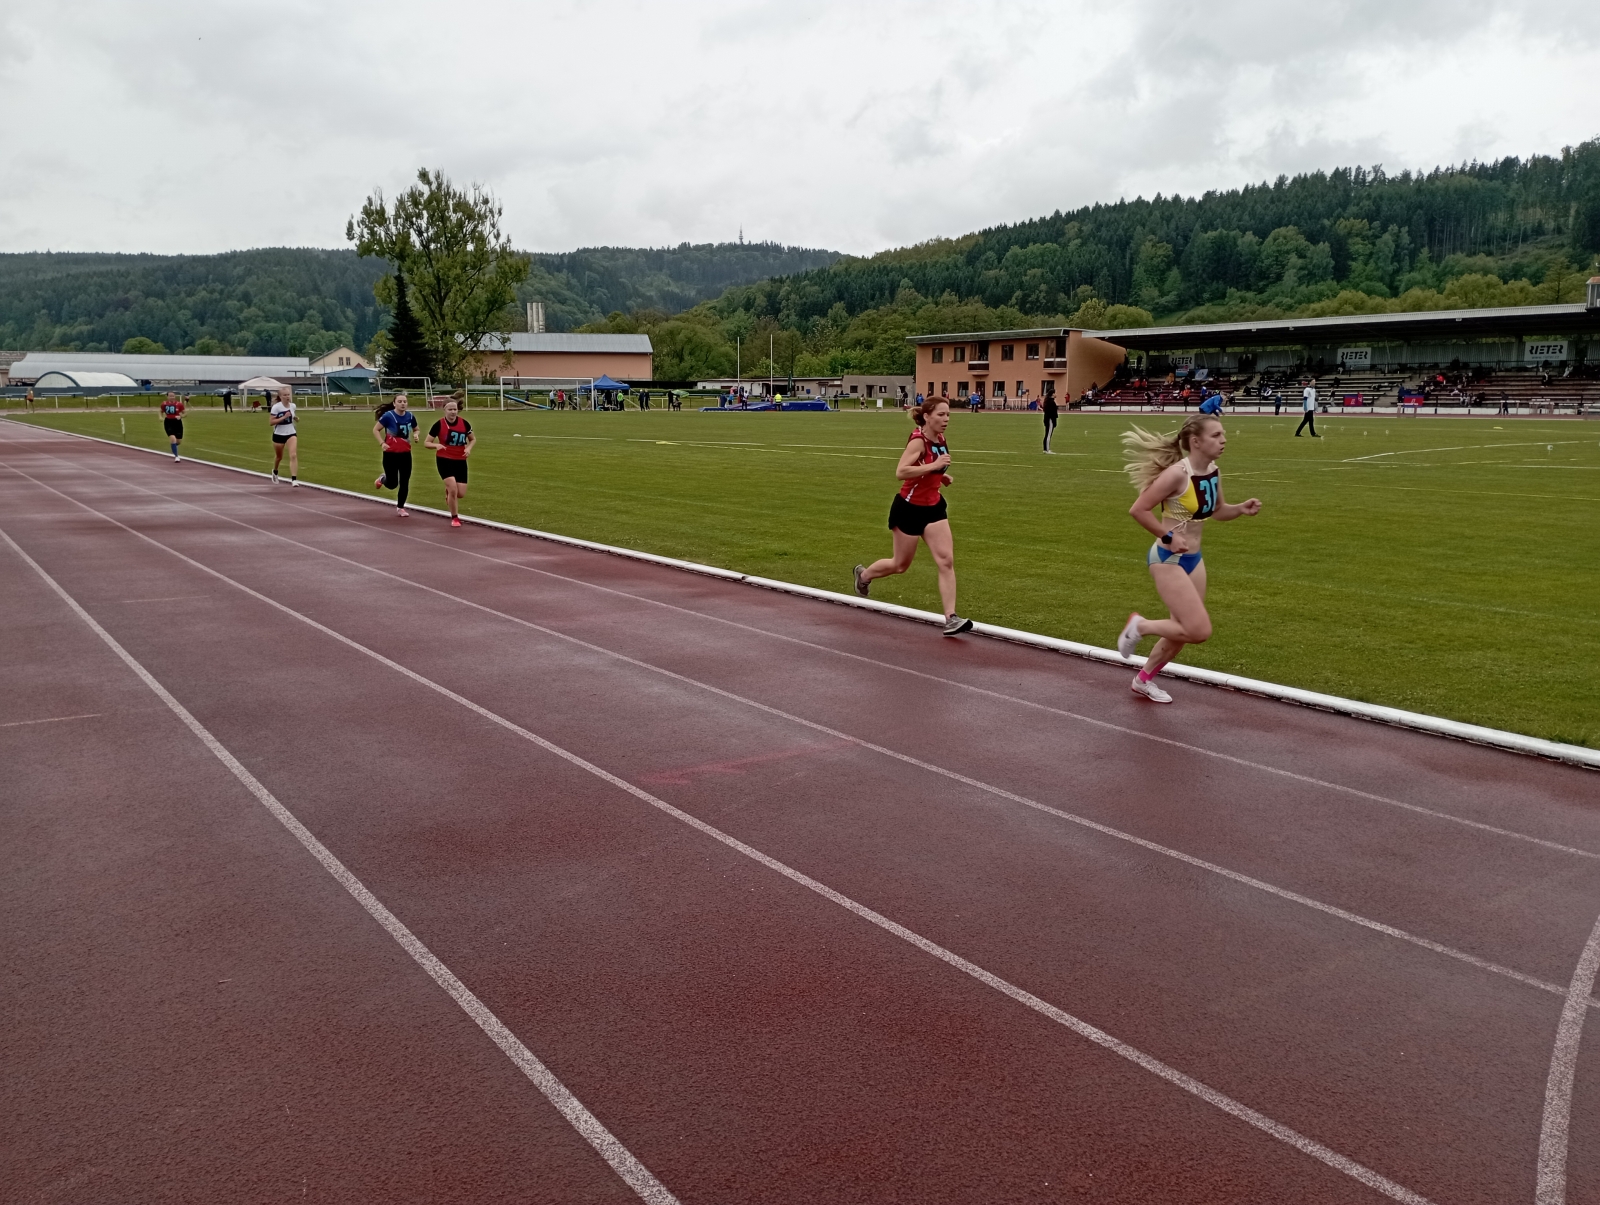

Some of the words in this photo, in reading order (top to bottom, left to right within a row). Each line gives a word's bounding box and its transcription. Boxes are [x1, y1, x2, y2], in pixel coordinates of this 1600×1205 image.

[1529, 345, 1564, 355] RIETER
[1341, 351, 1368, 360] RIETER
[1171, 356, 1192, 365] RIETER
